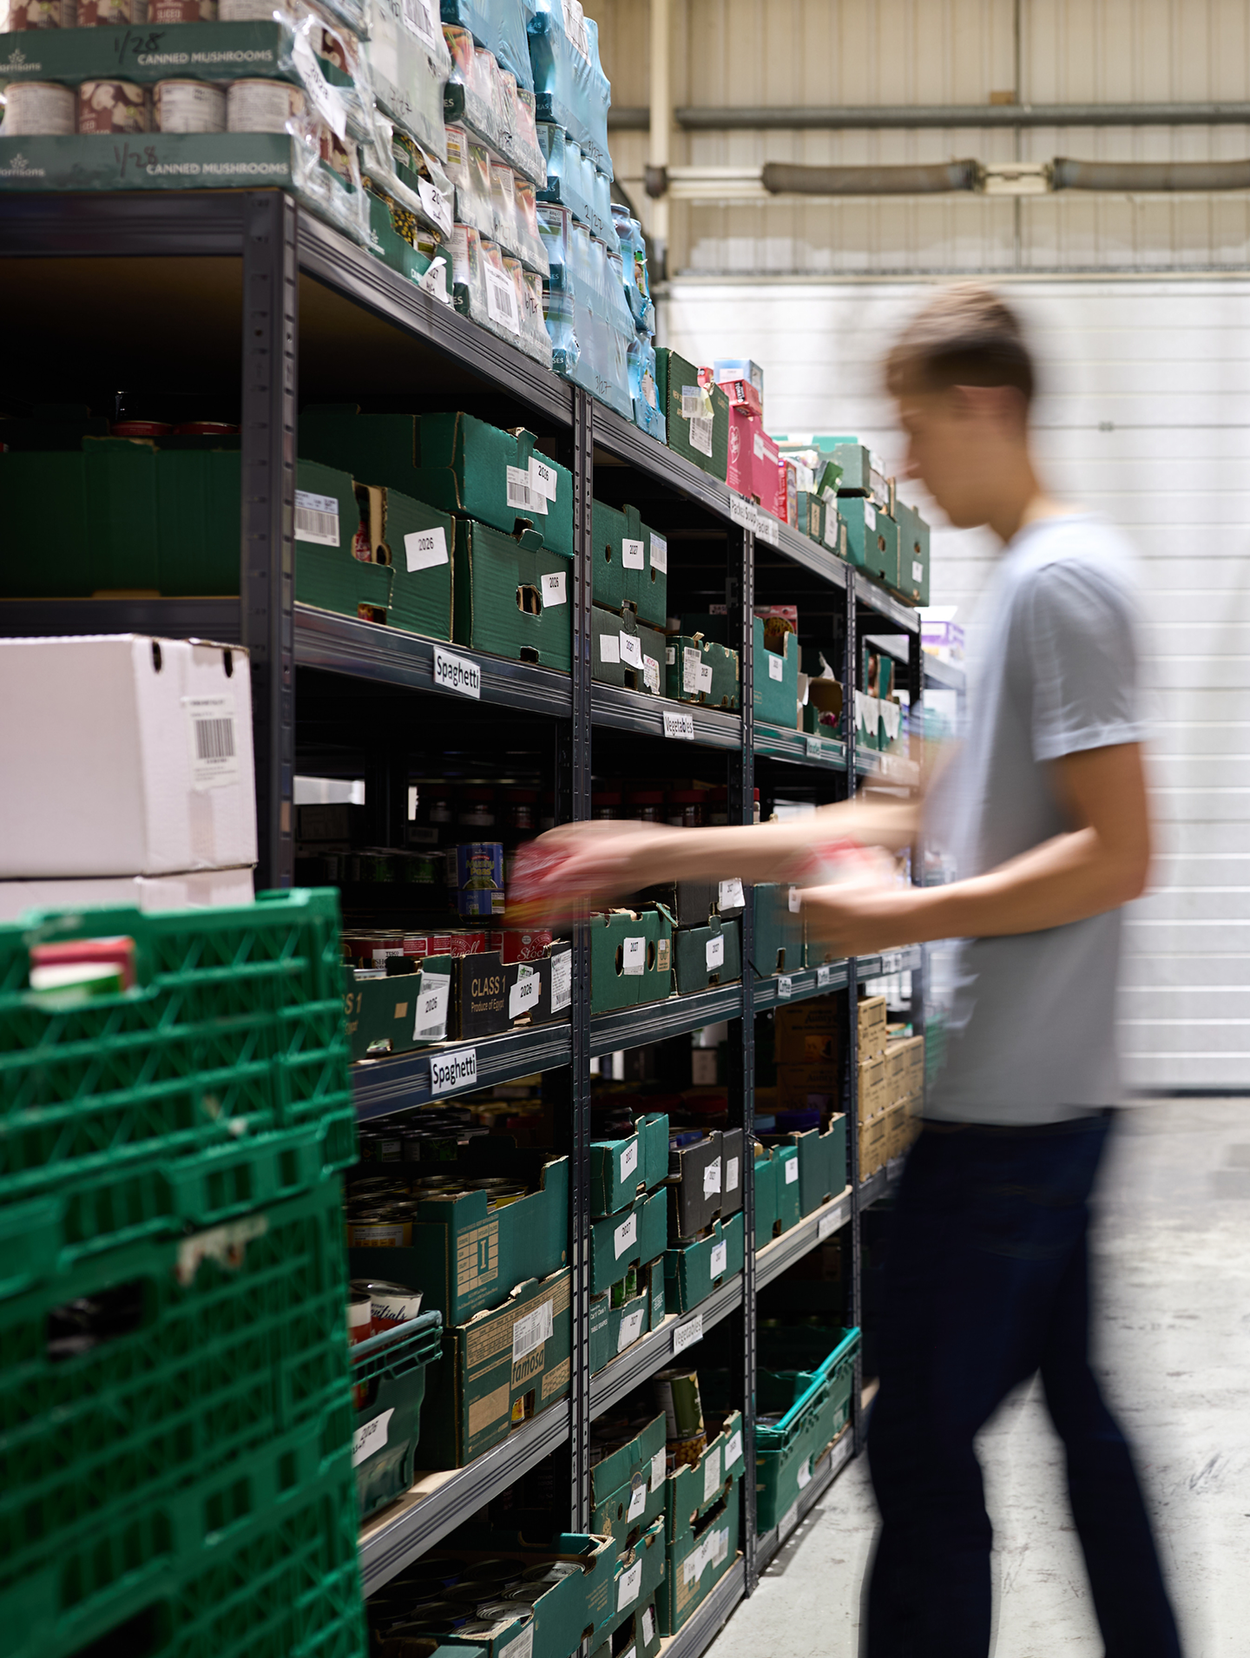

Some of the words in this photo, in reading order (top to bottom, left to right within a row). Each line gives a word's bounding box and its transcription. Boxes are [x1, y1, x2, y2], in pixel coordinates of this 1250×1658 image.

[0, 61, 42, 72] orrisons
[137, 52, 189, 66] CANNED
[190, 50, 273, 64] MUSHROOMS
[0, 167, 46, 177] orrisons
[146, 163, 200, 176] CANNED
[202, 162, 289, 175] MUSHROOMS
[418, 537, 434, 551] 2026
[436, 655, 481, 690] Spaghetti
[664, 716, 693, 736] Vegetables
[470, 867, 492, 876] Peas
[472, 976, 501, 997] CLASS
[501, 975, 506, 993] 1
[520, 982, 533, 999] 2026
[425, 996, 438, 1014] 2026
[471, 1001, 487, 1013] Produce
[433, 1056, 477, 1088] Spaghetti
[675, 1318, 702, 1347] Vegetables
[512, 1350, 544, 1385] famosa
